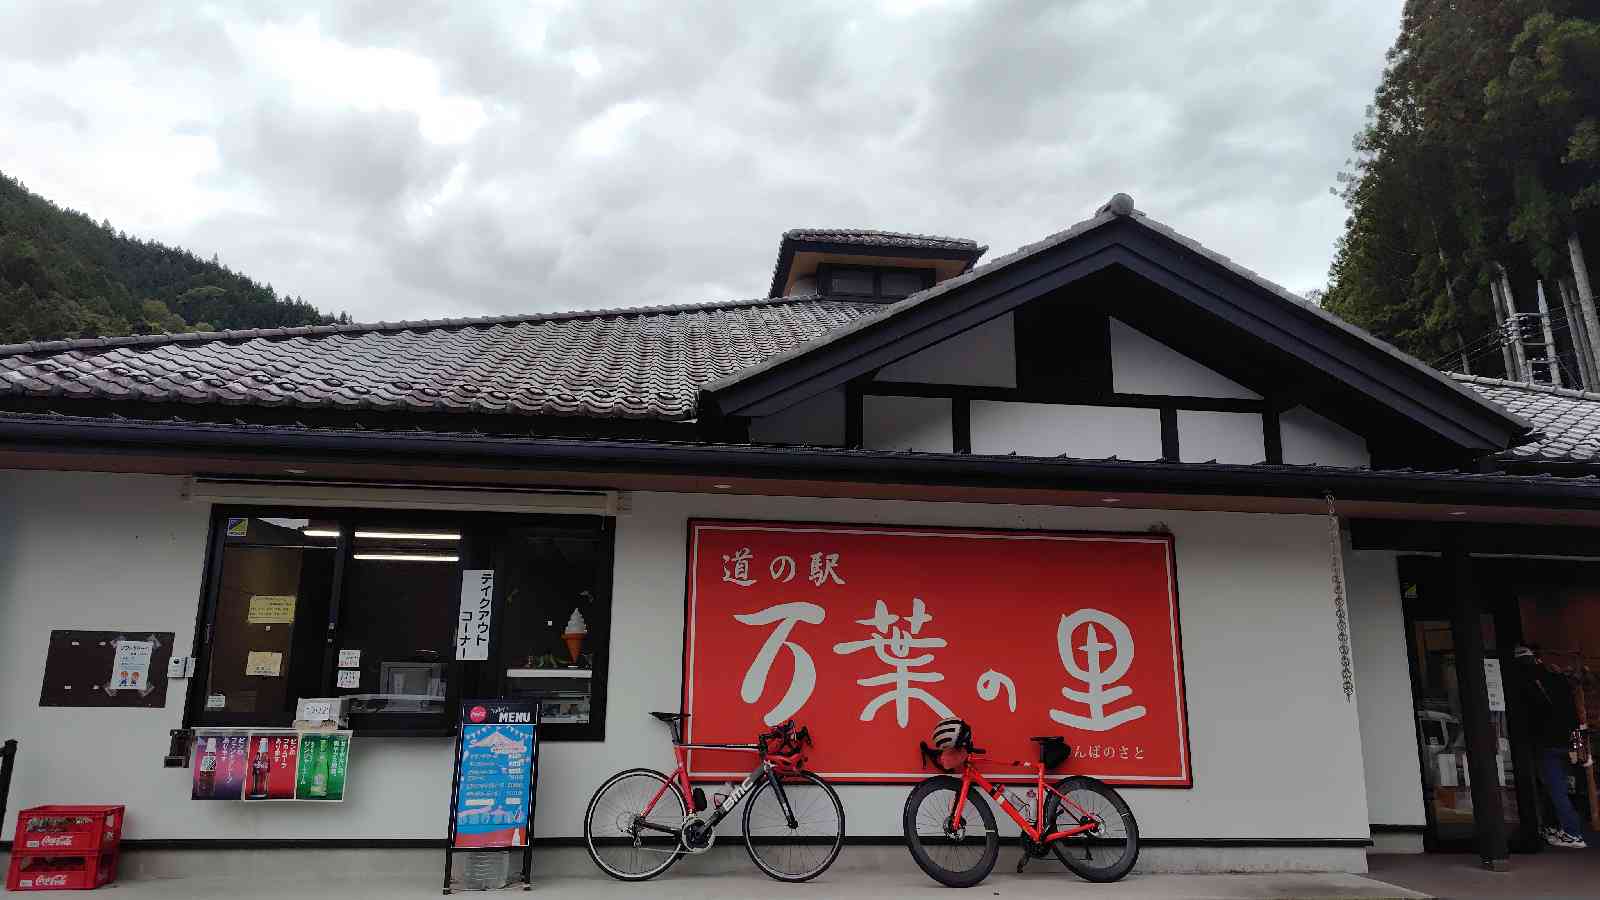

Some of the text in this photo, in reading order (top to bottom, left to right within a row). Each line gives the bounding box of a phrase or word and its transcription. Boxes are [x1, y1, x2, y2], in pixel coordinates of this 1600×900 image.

[721, 547, 847, 587] 道の駅
[477, 573, 492, 646] テイクアウト
[459, 611, 473, 659] コーナー
[733, 598, 1147, 731] 万葉の里
[499, 711, 531, 723] MENU
[1072, 744, 1145, 760] んばのさと
